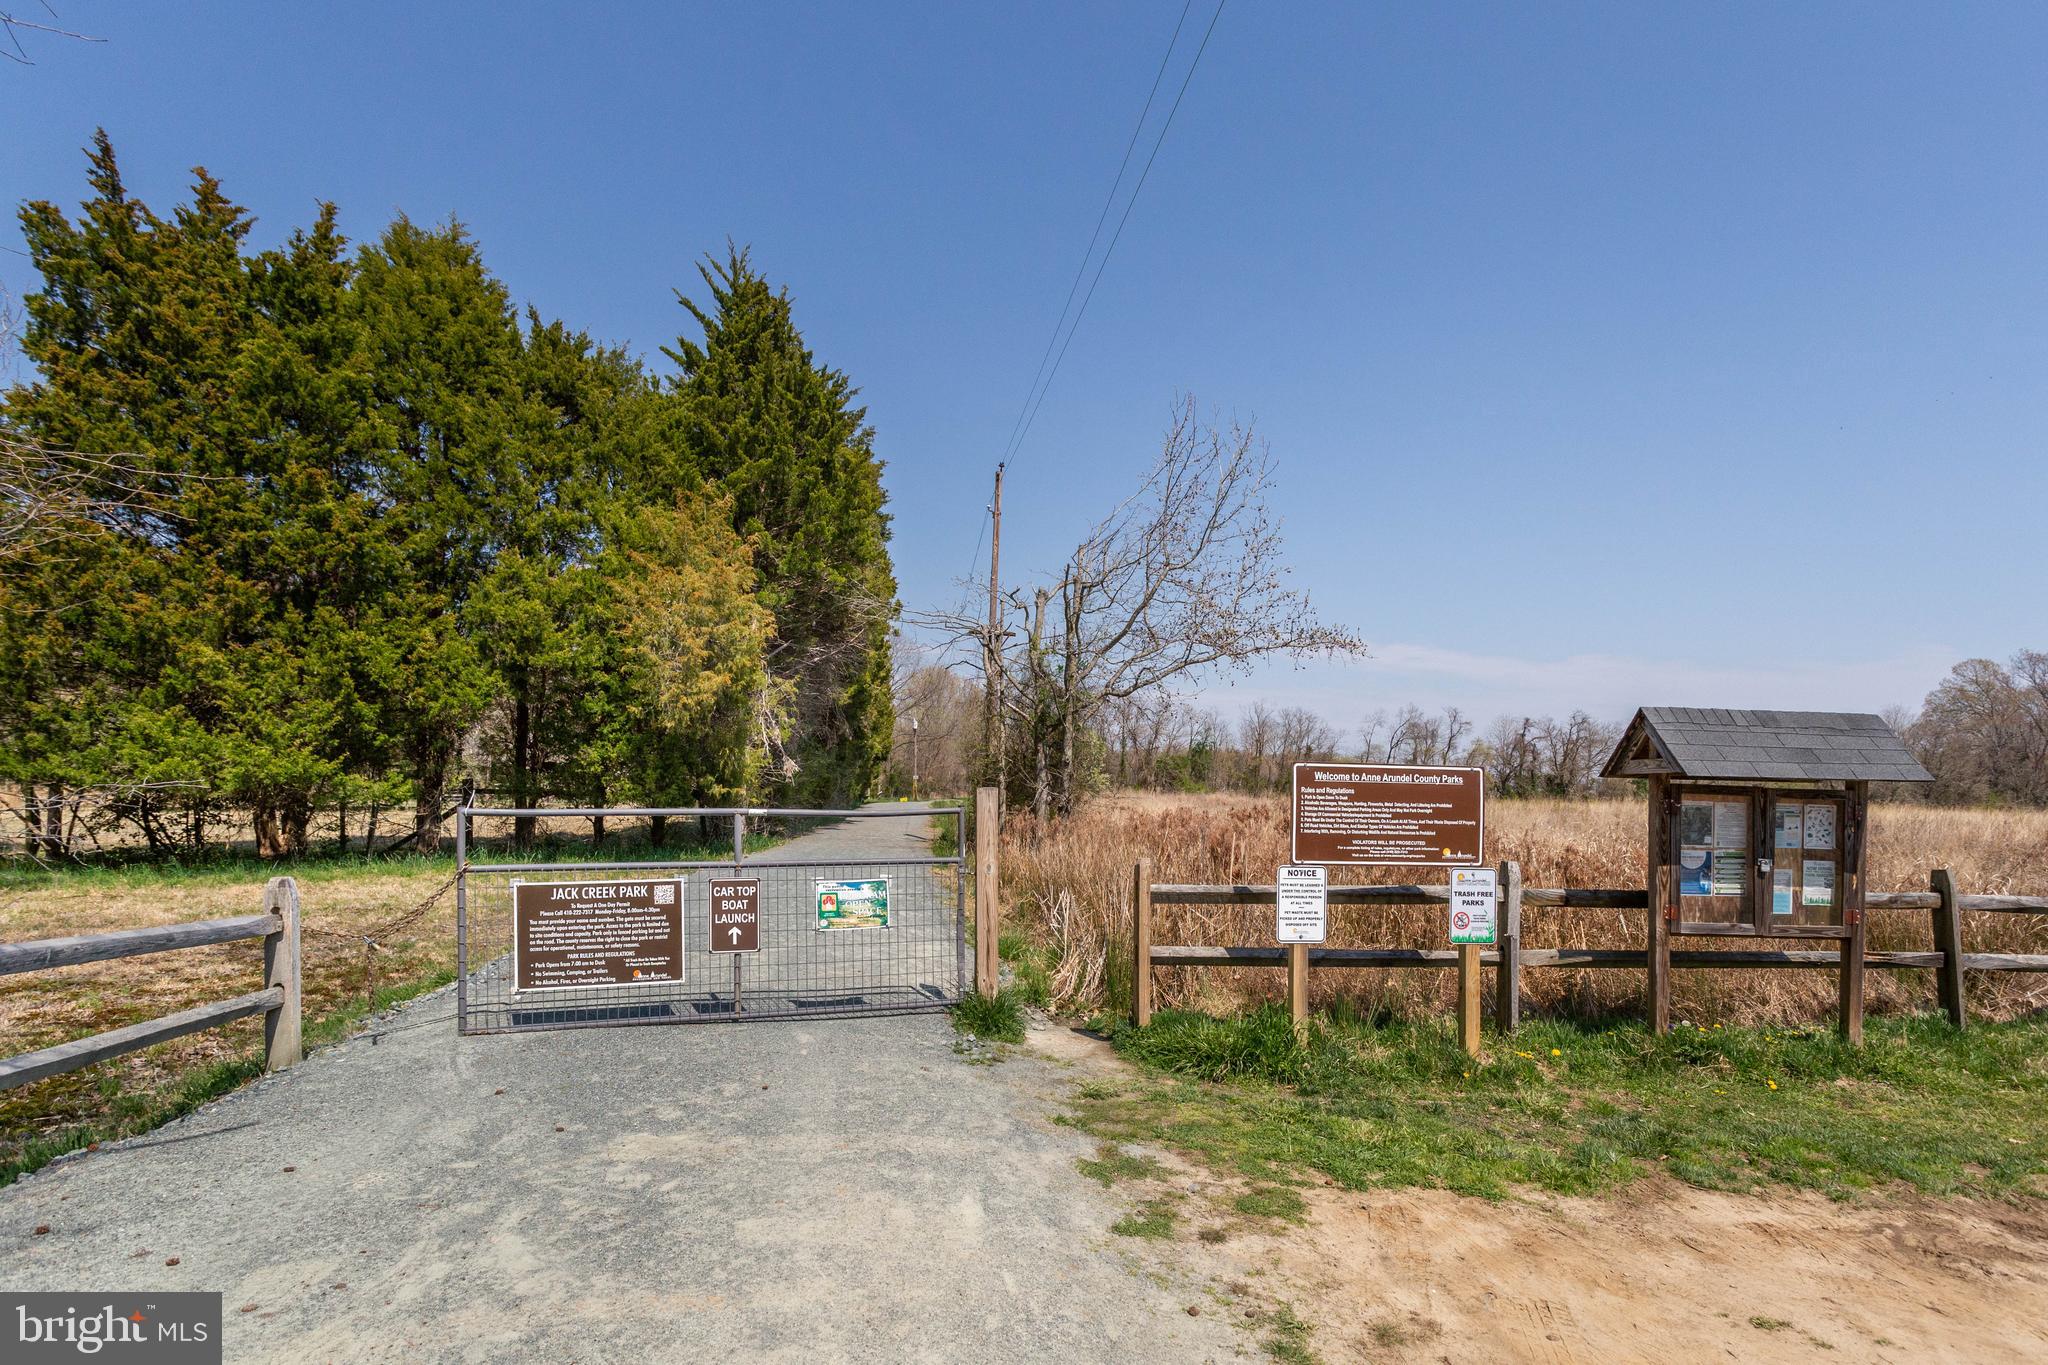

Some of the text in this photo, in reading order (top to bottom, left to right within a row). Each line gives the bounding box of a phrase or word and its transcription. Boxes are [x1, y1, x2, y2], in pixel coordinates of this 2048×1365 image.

[1314, 772, 1464, 785] Welcome to Anne Arundel County Parks
[551, 885, 648, 900] JACK CREEK PARK
[714, 886, 756, 896] CAR TOP
[722, 900, 748, 910] BOAT
[853, 907, 881, 915] SPACE
[715, 913, 755, 923] LAUNCH
